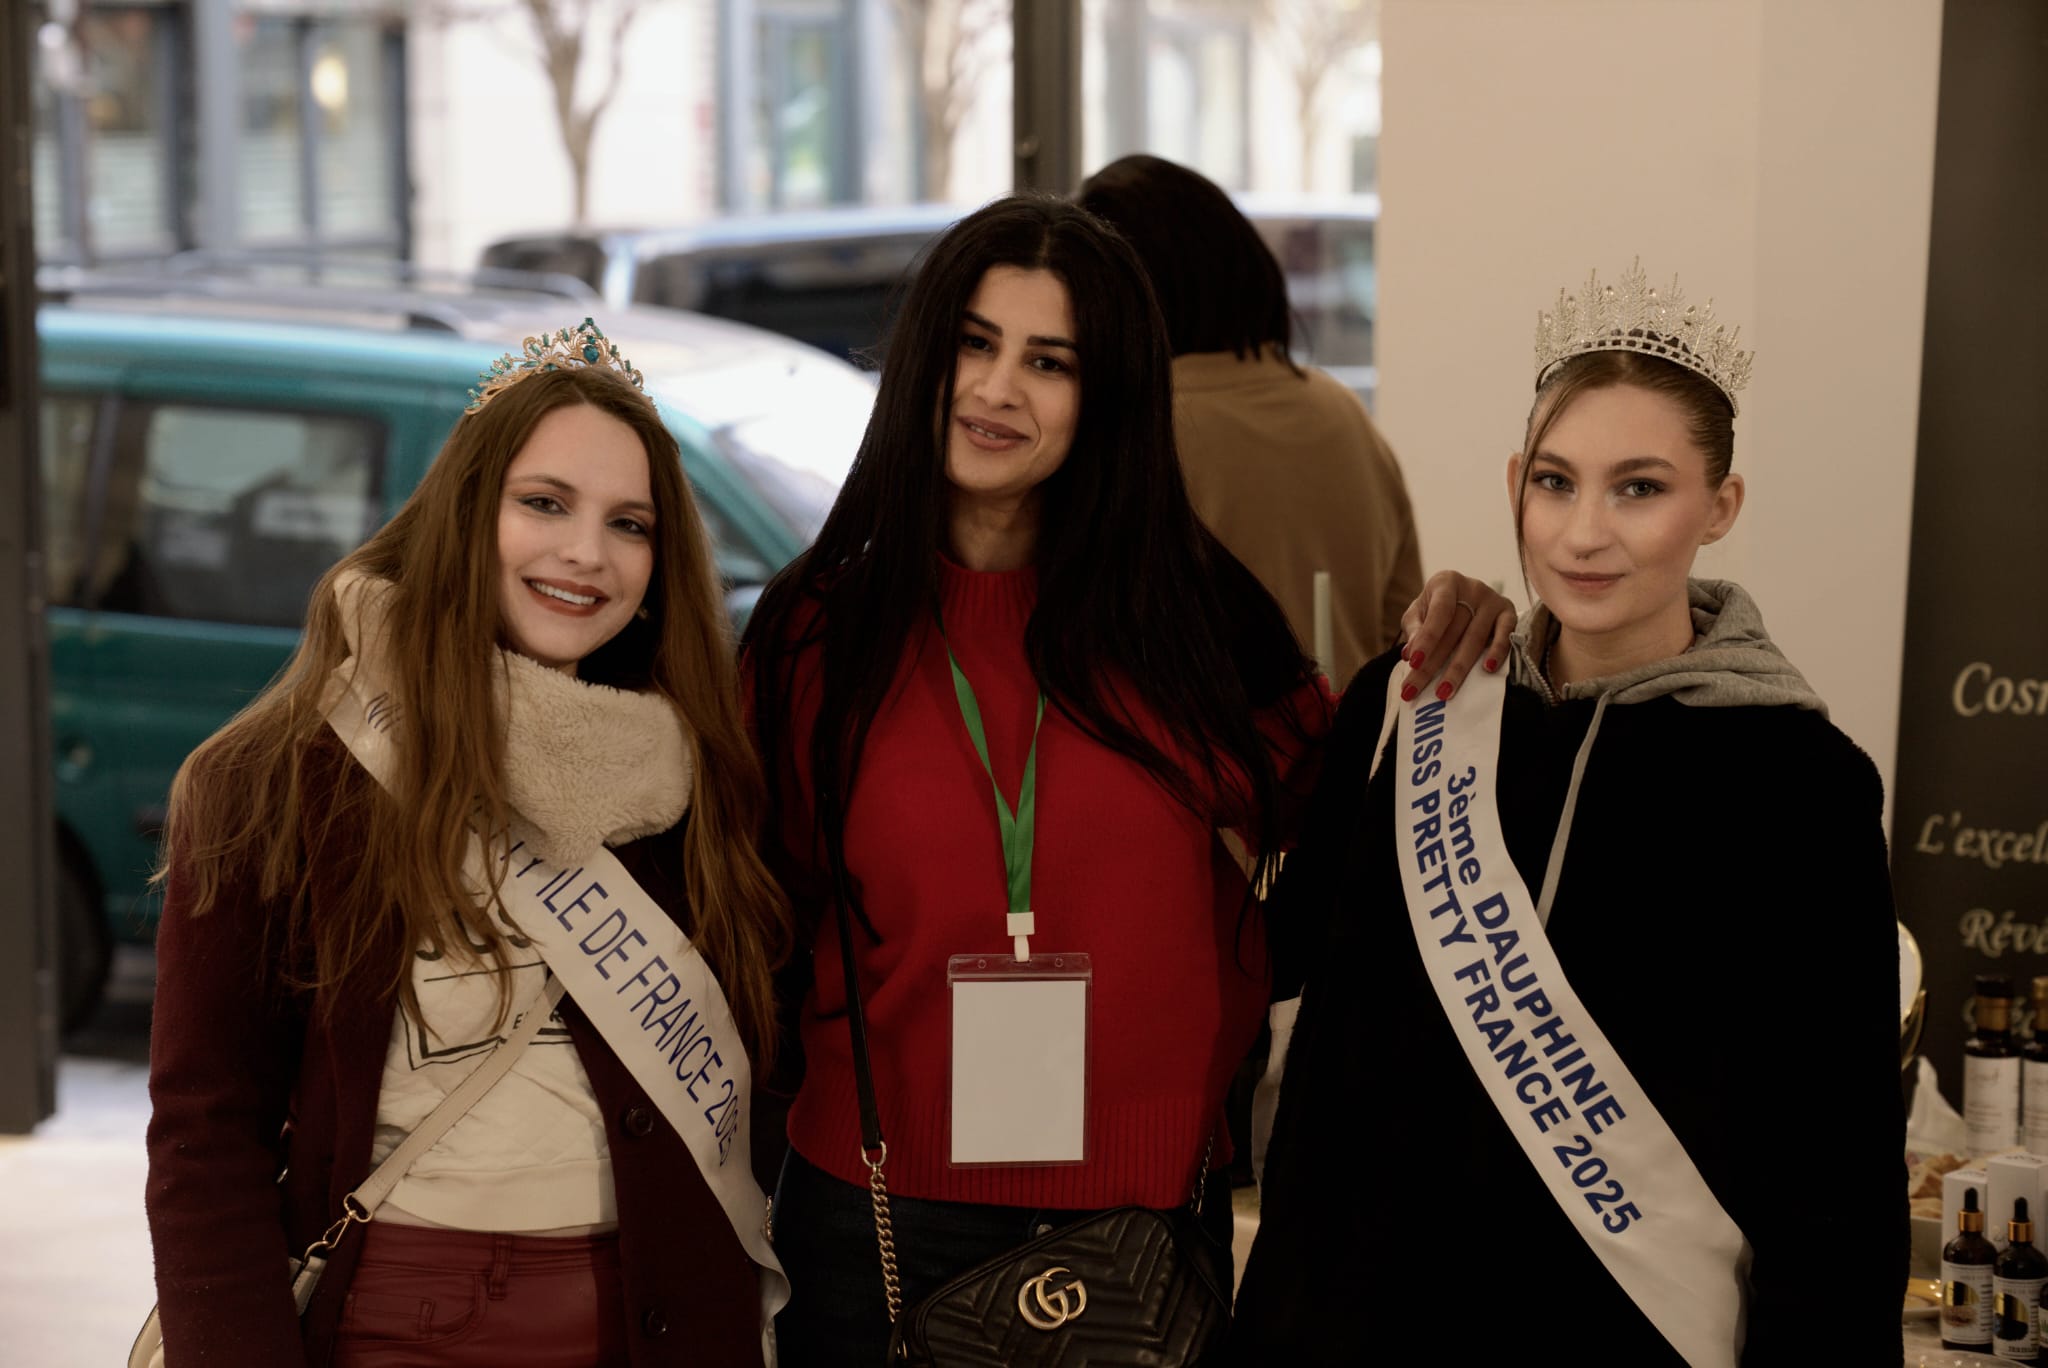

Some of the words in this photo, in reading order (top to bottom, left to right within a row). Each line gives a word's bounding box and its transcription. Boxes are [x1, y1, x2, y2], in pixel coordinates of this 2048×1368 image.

[1411, 700, 1446, 786] MISS
[1411, 789, 1477, 947] PRETTY
[1915, 810, 2048, 869] L'excel
[536, 867, 609, 932] ILE
[576, 908, 648, 980] DE
[616, 955, 723, 1103] FRANCE
[1447, 766, 1482, 885] 3ème
[1473, 892, 1626, 1134] DAUPHINE
[1454, 958, 1571, 1133] FRANCE
[1553, 1135, 1642, 1234] 2025
